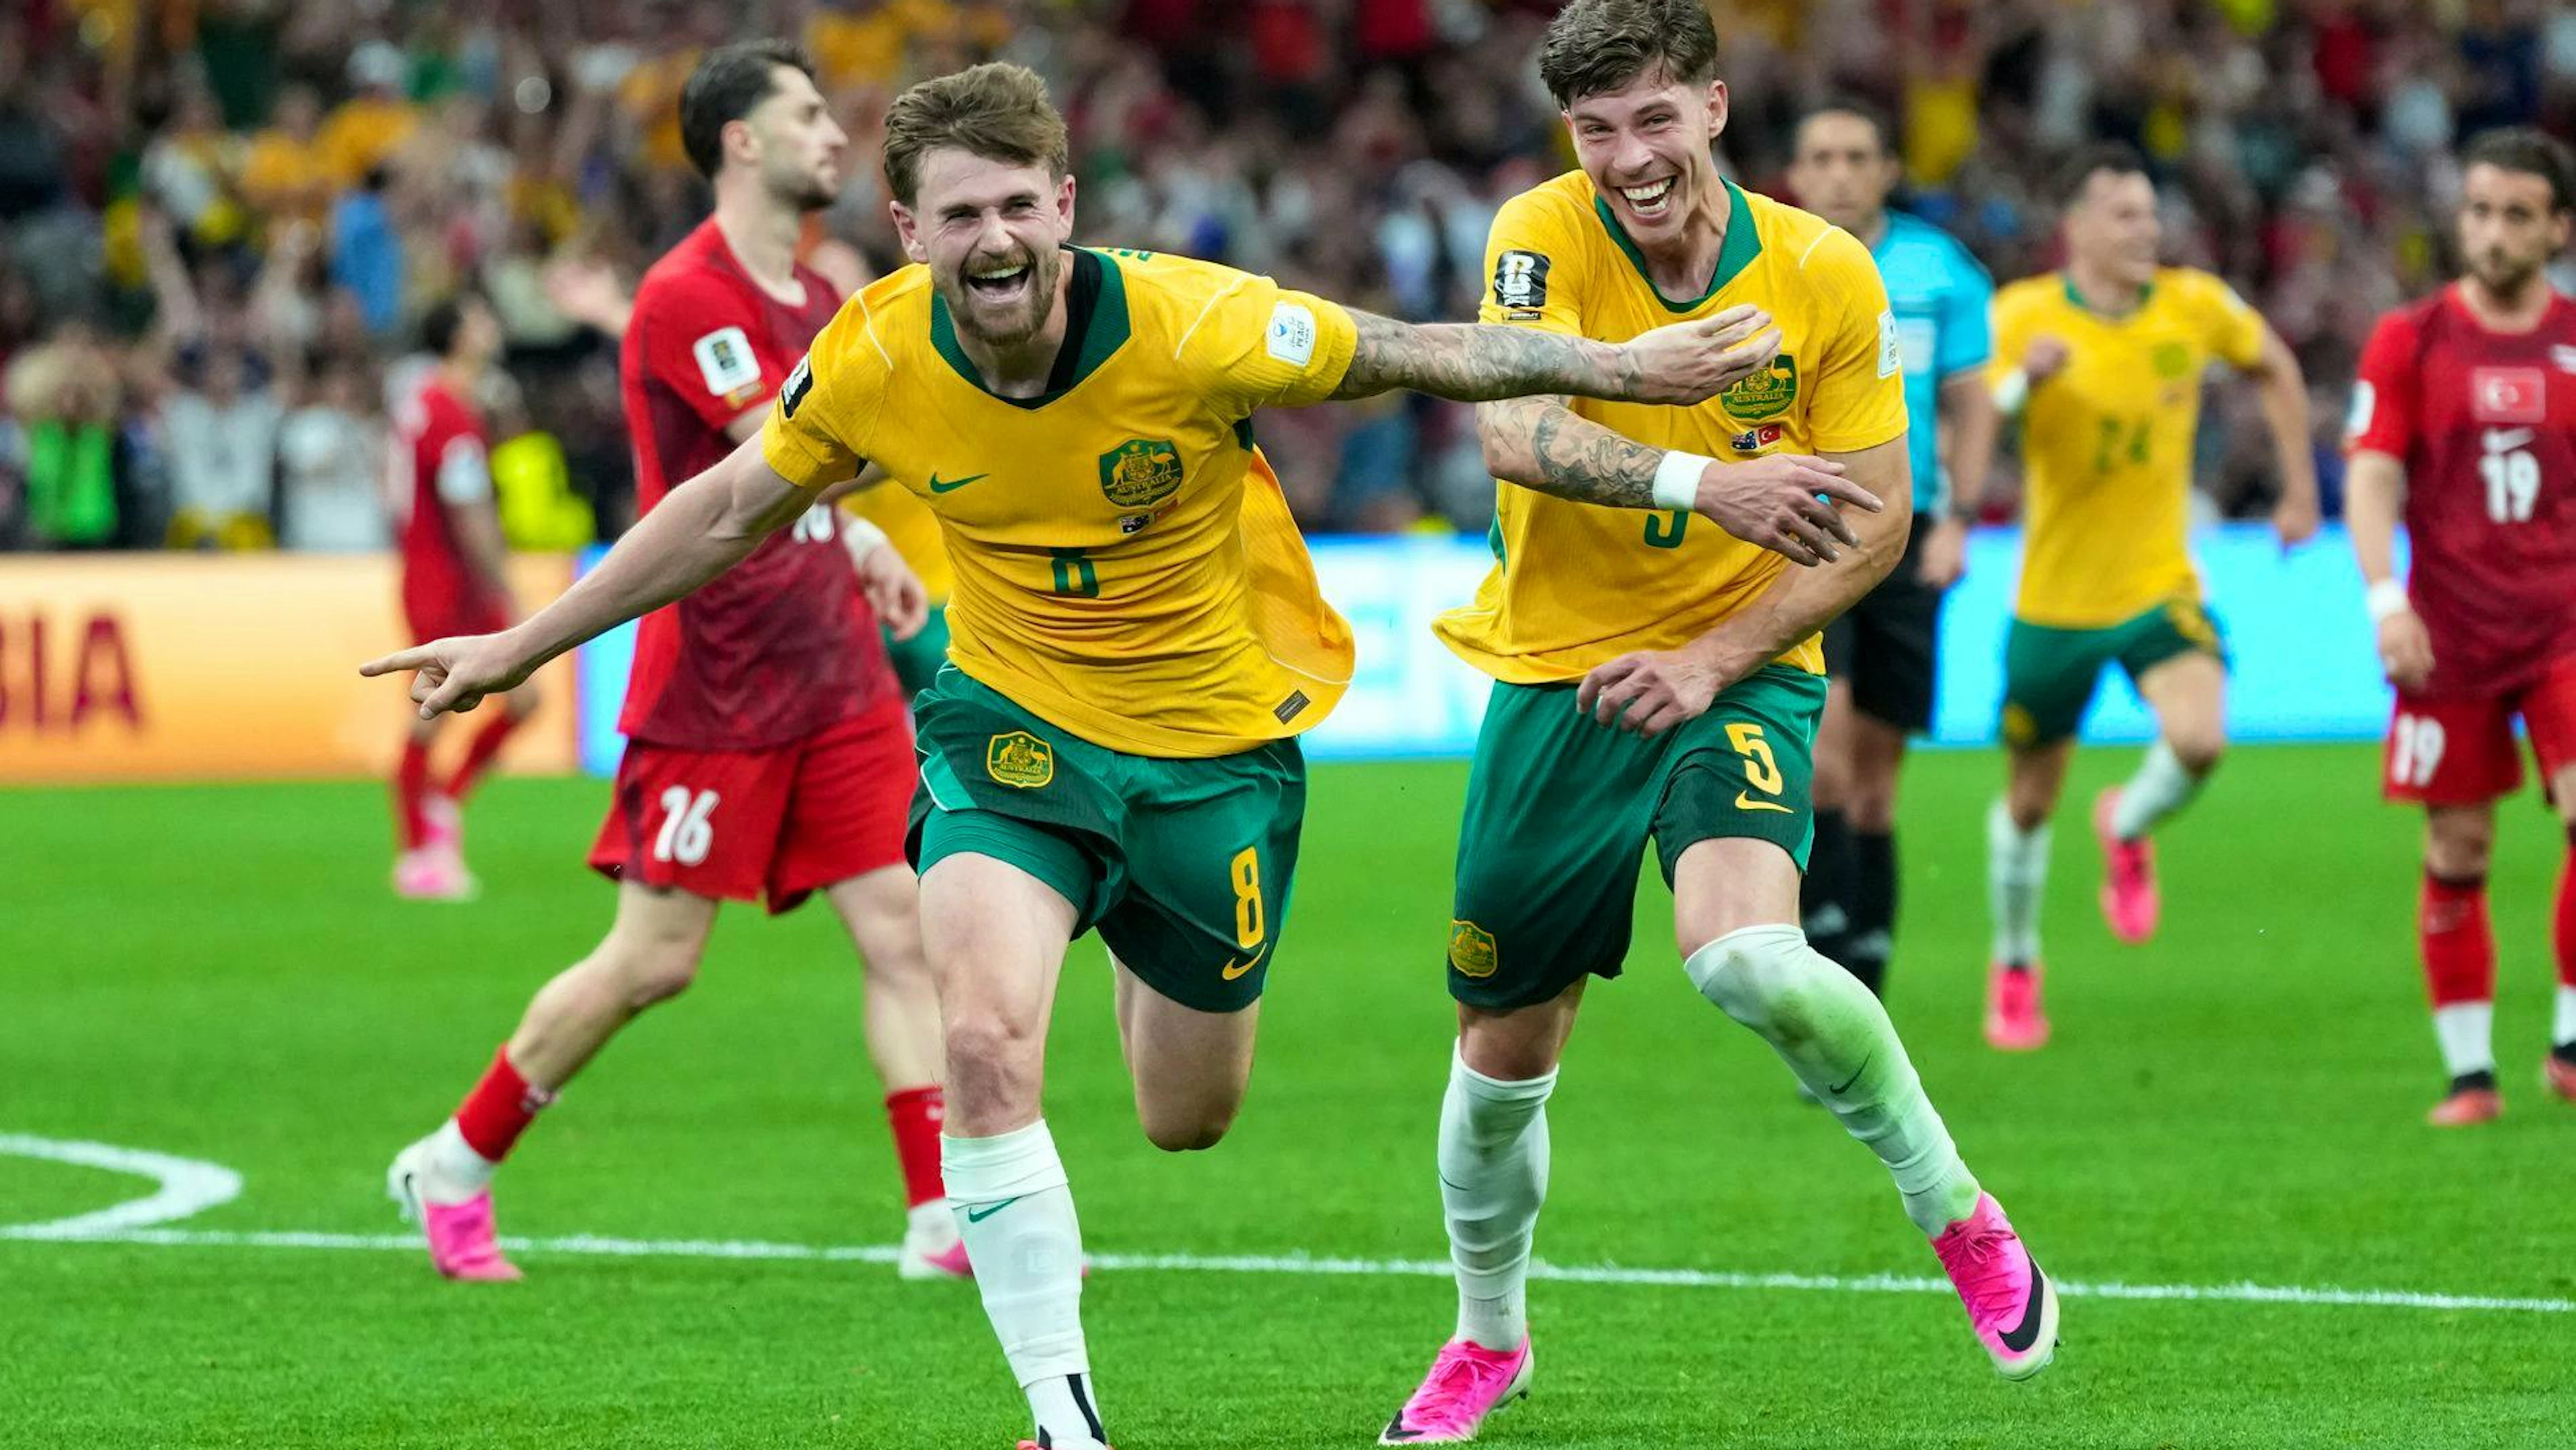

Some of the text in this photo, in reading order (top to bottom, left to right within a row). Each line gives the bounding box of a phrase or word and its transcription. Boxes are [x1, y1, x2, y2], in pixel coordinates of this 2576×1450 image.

[2478, 450, 2541, 524] 19
[0, 615, 142, 728] IA
[1724, 723, 1782, 796] 5
[2394, 712, 2446, 787] 19
[653, 784, 721, 867] 16
[1231, 845, 1265, 949] 8
